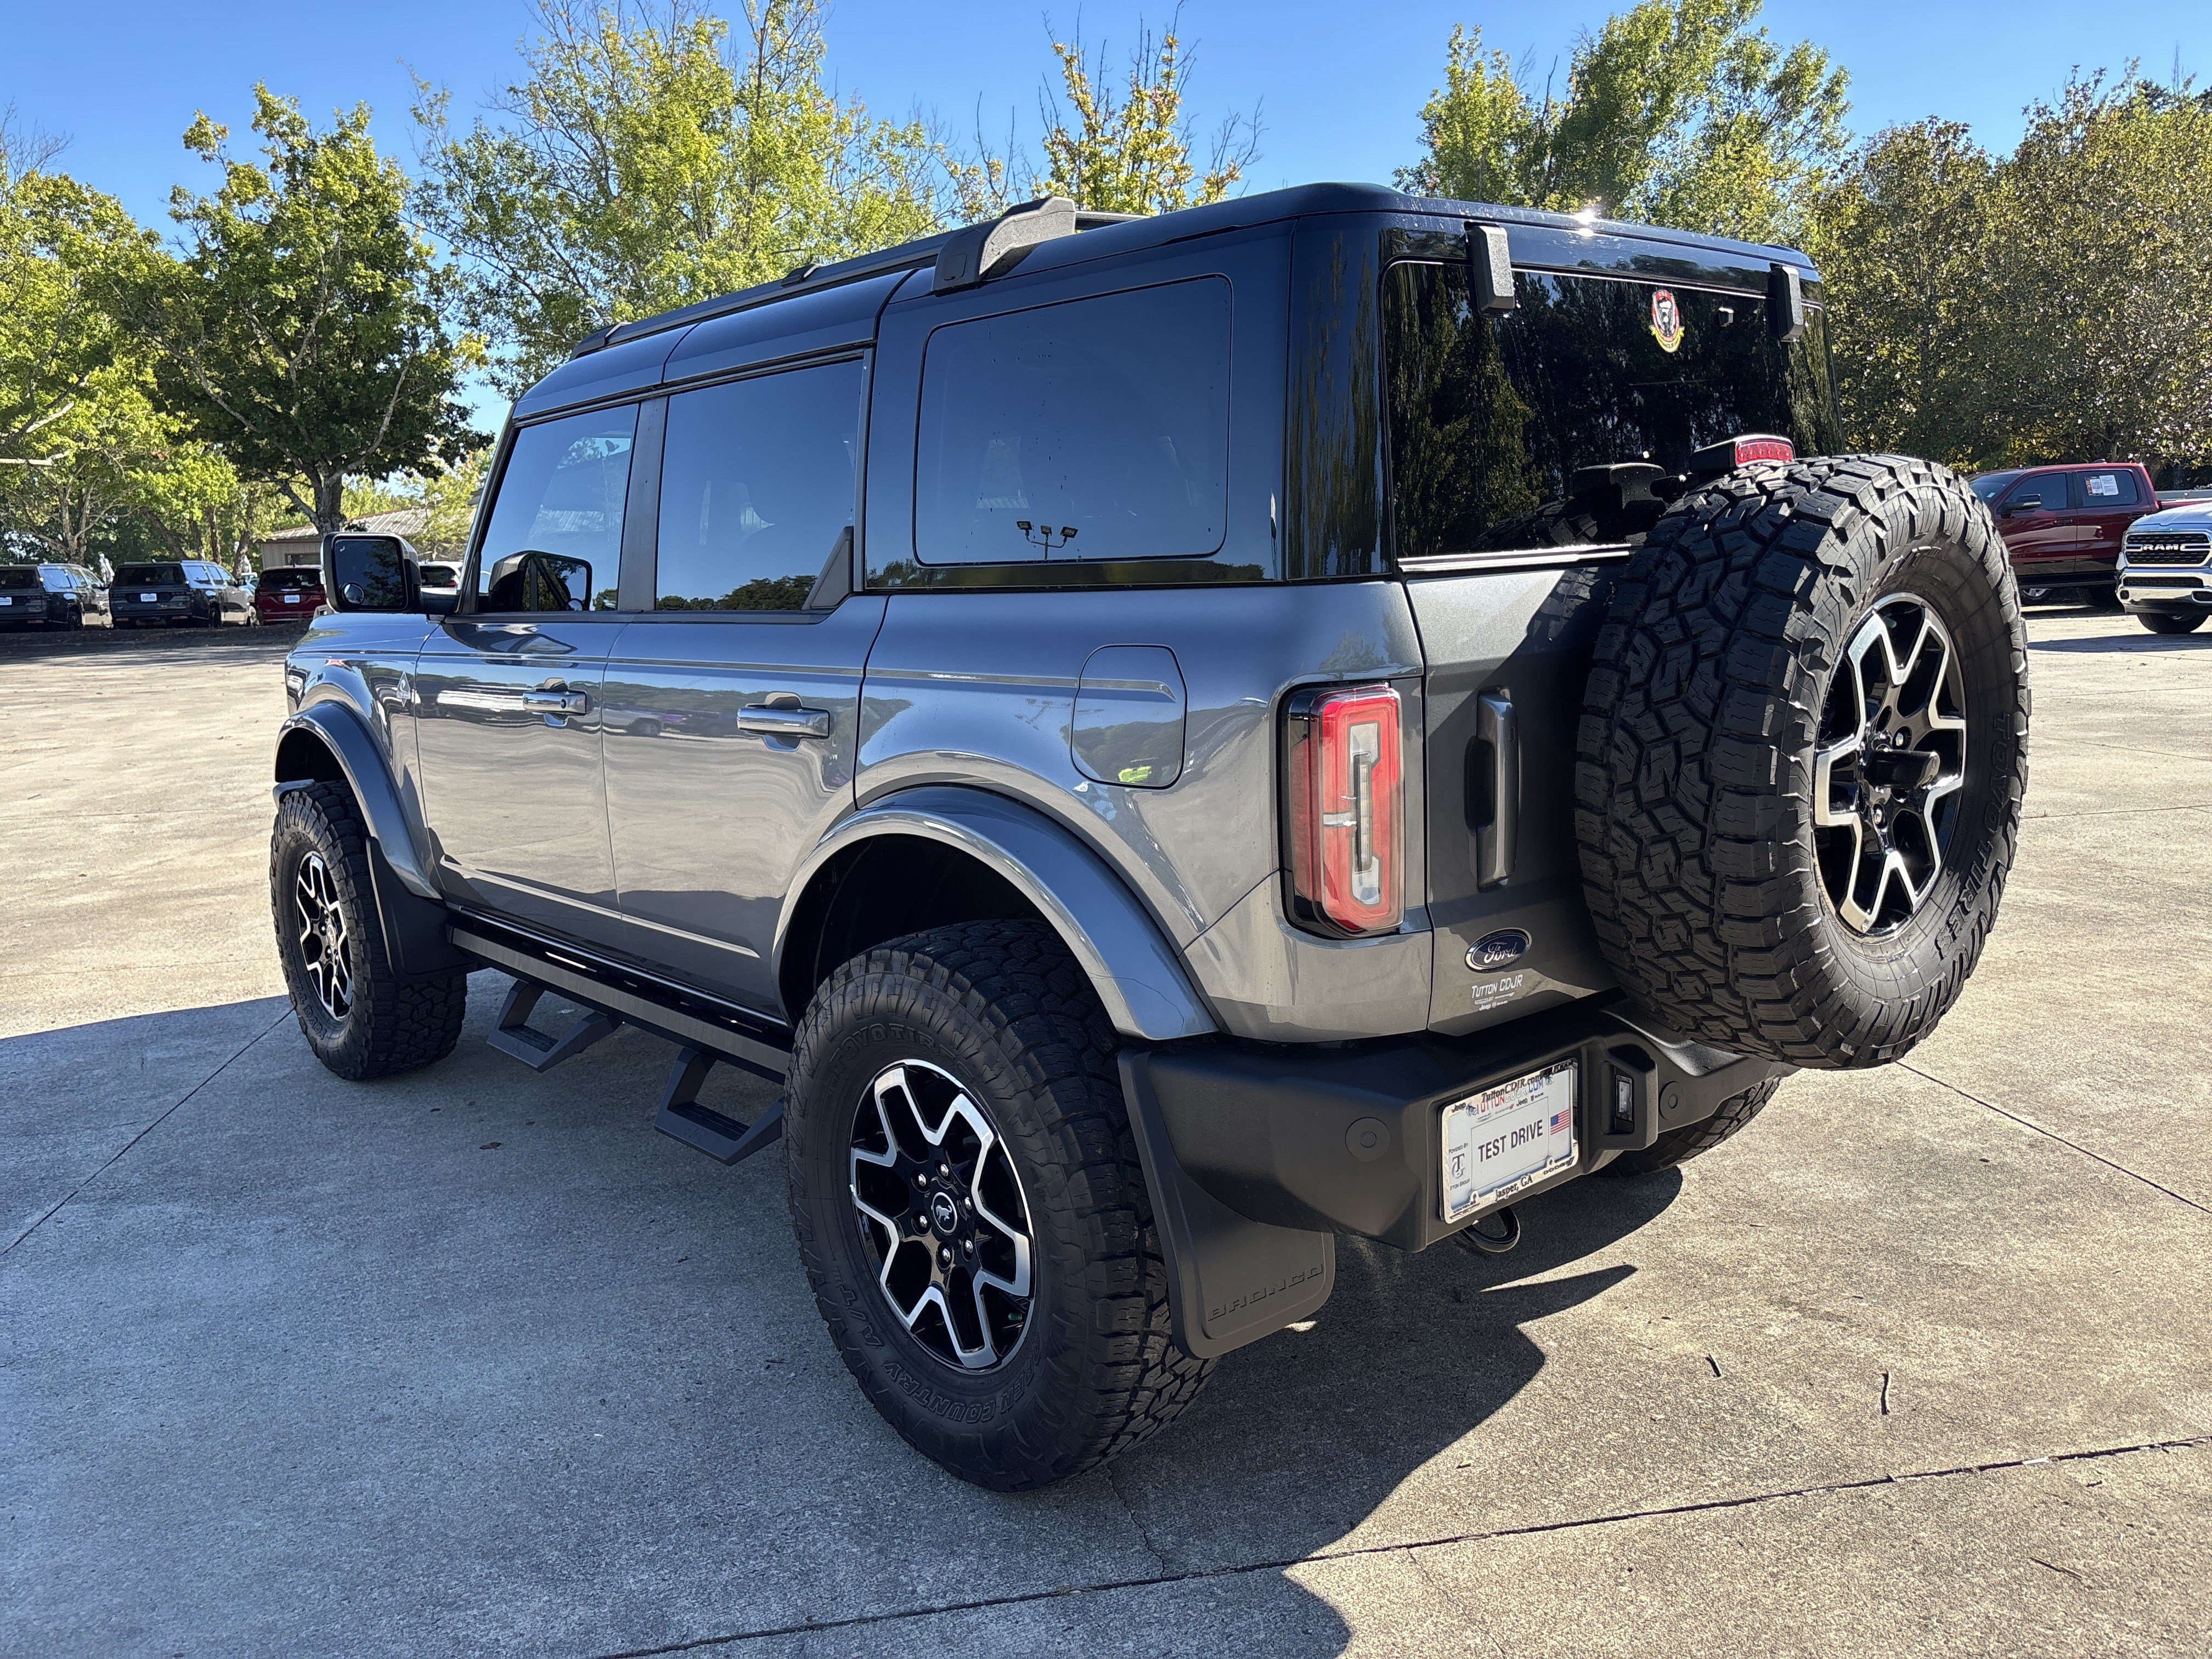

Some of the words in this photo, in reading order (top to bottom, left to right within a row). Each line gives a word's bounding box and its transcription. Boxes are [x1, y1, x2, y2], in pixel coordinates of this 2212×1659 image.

[1984, 713, 2010, 833] TOYO
[1936, 840, 1994, 961] TIRES
[1483, 942, 1518, 963] Ford
[1499, 974, 1523, 992] CDJR
[829, 1023, 888, 1070] TOYO
[1451, 1103, 1466, 1113] Jeep
[1516, 1098, 1528, 1107] Jeep
[1478, 1135, 1506, 1163] TEST
[1511, 1119, 1543, 1149] DRIVE
[1495, 1182, 1519, 1202] Jasper,
[1520, 1173, 1533, 1187] GA
[1208, 1263, 1324, 1322] BRONCO
[838, 1285, 884, 1347] A/T
[881, 1362, 997, 1425] COUNTRY
